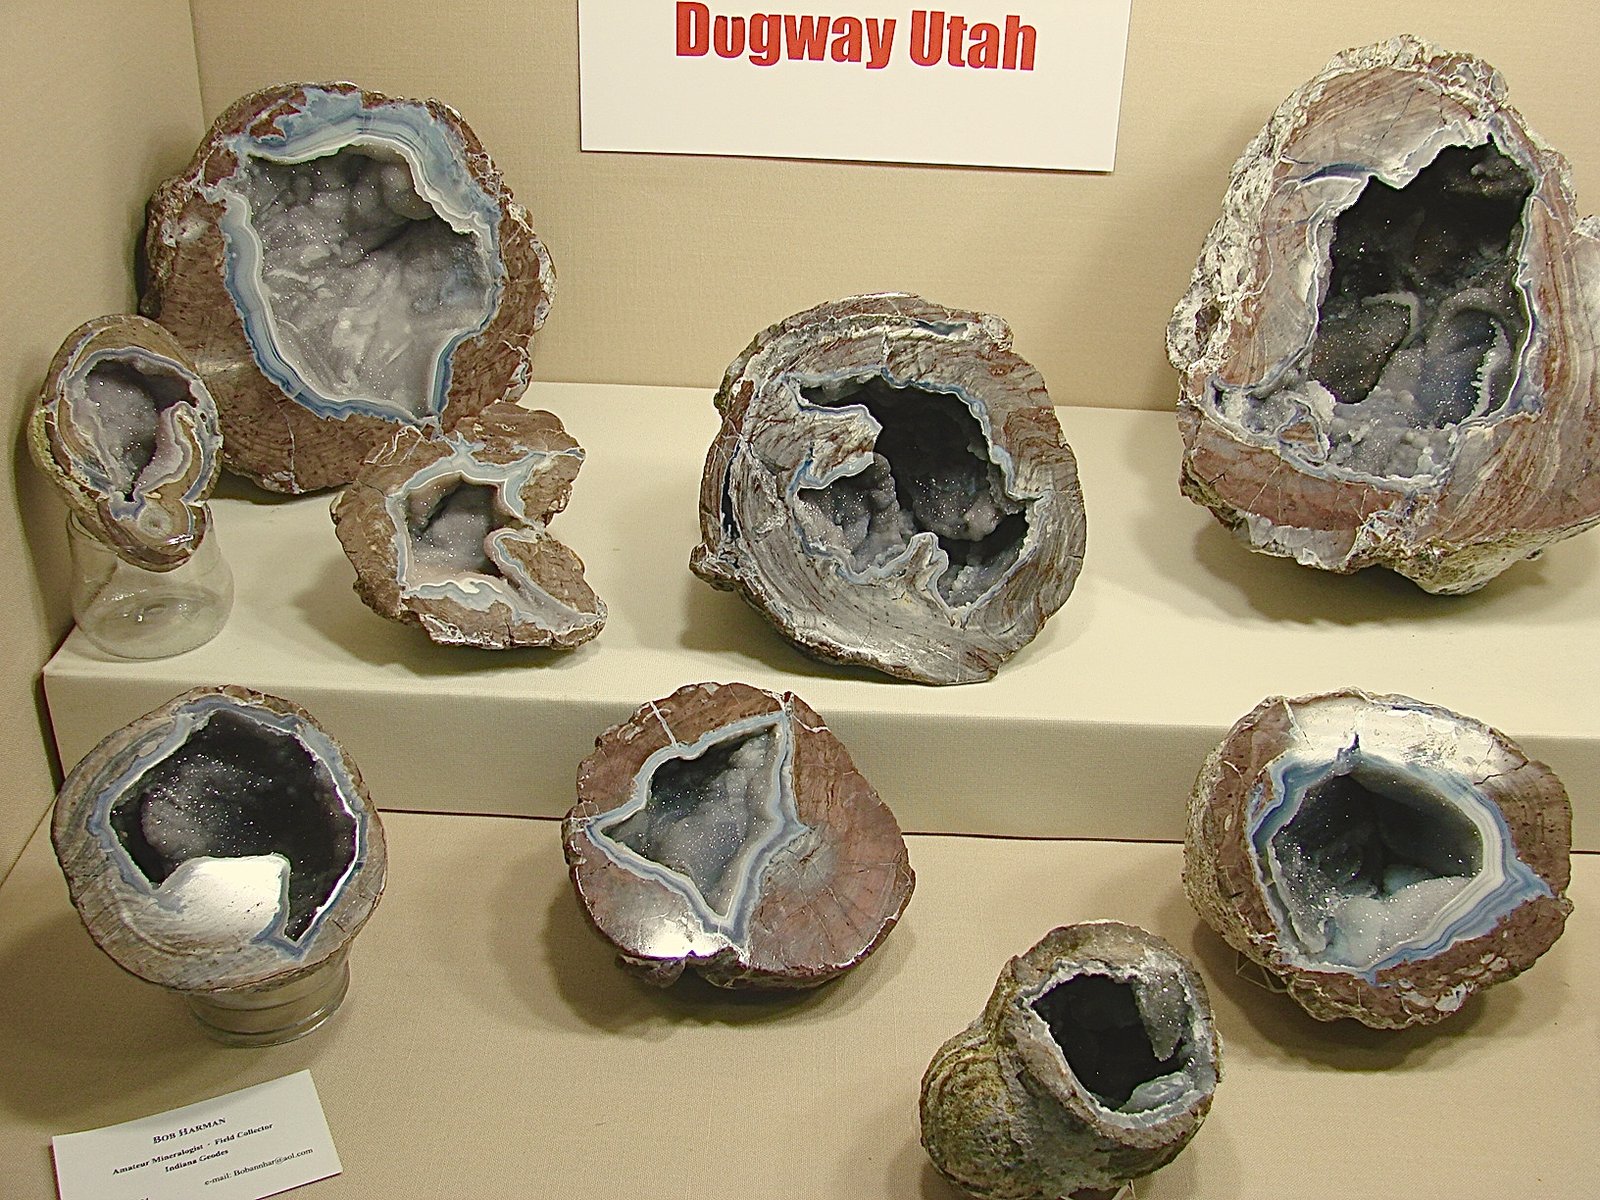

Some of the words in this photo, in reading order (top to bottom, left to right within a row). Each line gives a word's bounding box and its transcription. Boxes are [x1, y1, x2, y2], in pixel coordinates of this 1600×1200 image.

[676, 1, 897, 69] Dugway
[910, 10, 1037, 71] Utah
[112, 1160, 150, 1175] Amateur
[151, 1144, 204, 1164] Mineralogist
[214, 1133, 235, 1145] Field
[237, 1123, 273, 1138] Collector
[165, 1159, 197, 1173] Indiana
[199, 1149, 229, 1162] Geodes
[204, 1172, 232, 1186] e-mail:
